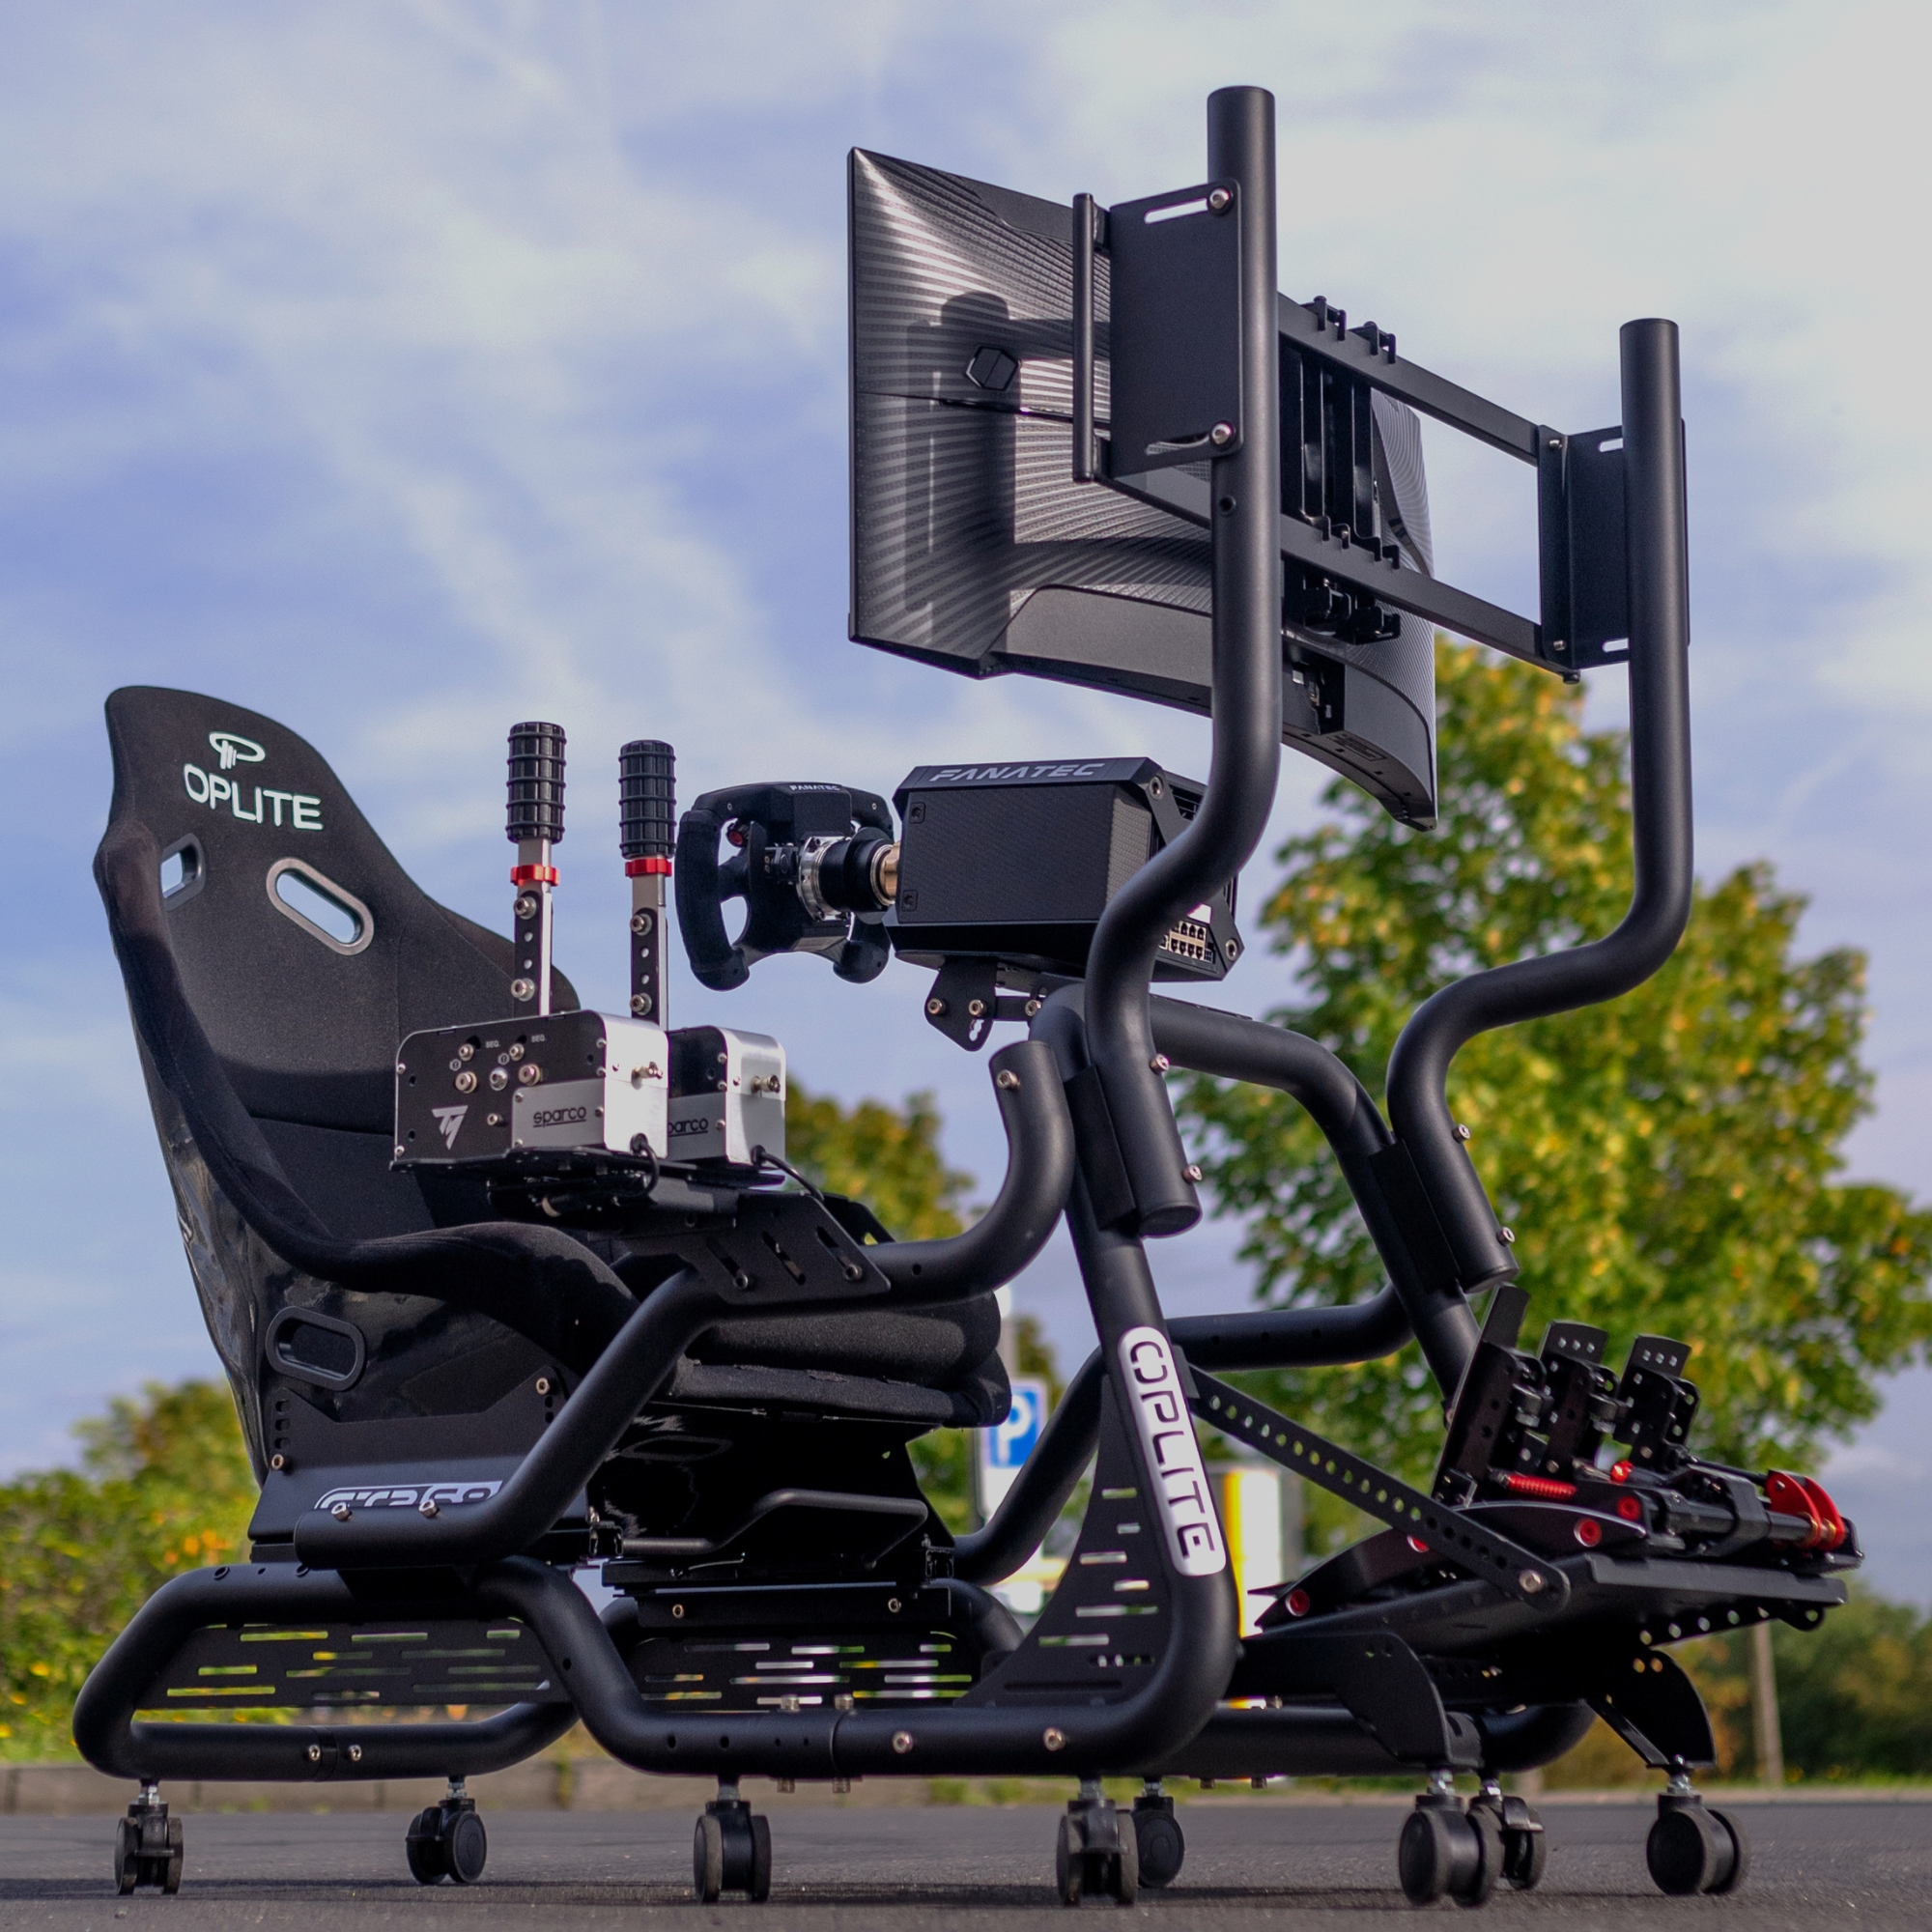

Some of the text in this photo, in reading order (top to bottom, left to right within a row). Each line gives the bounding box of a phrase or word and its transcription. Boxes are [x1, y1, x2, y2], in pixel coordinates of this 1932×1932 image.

[184, 763, 324, 831] OPLITE
[929, 763, 1105, 782] FANATEC
[533, 1106, 587, 1128] sparco
[997, 1393, 1032, 1464] P
[1129, 1341, 1215, 1560] OPLITE
